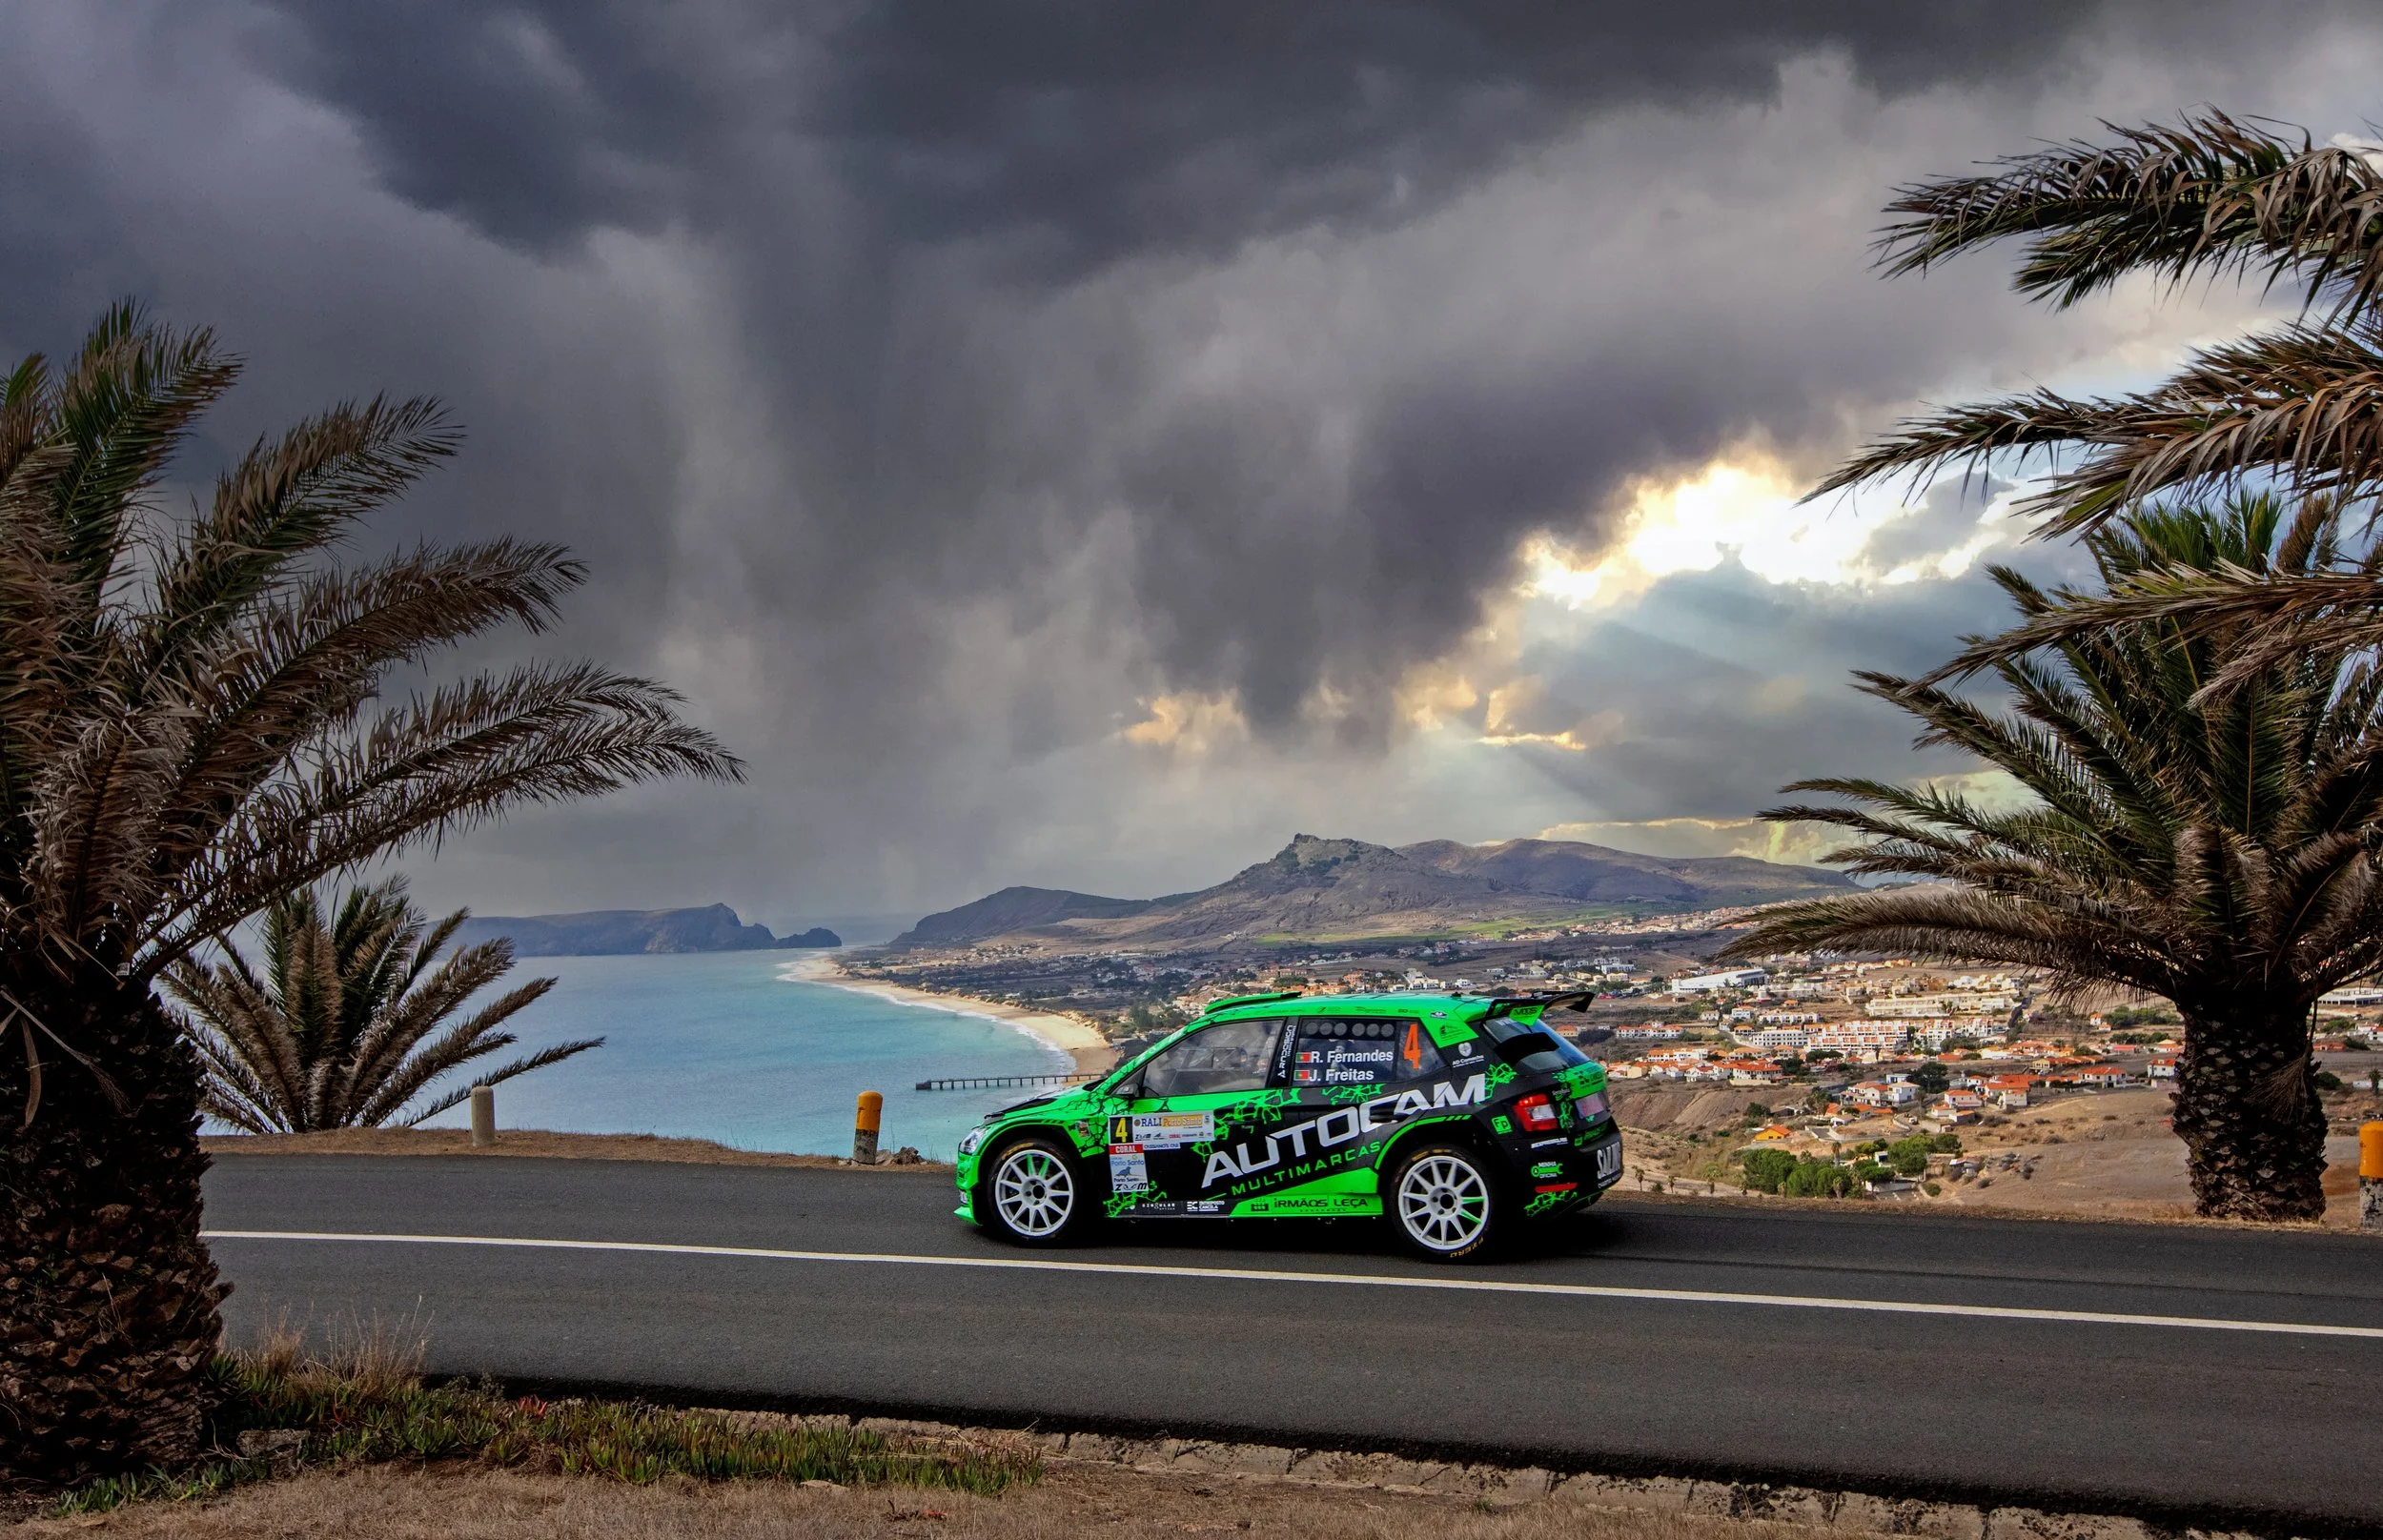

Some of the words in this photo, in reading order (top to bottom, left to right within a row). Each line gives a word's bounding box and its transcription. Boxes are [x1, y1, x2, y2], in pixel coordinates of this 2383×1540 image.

[1310, 1051, 1324, 1064] R.
[1327, 1049, 1394, 1064] Fernandes
[1403, 1023, 1421, 1070] 4
[1309, 1070, 1322, 1082] J.
[1325, 1069, 1375, 1082] Freitas
[1115, 1117, 1129, 1144] 4
[1141, 1117, 1162, 1127] RALI
[1201, 1073, 1486, 1188] AUTOCAM
[1231, 1141, 1381, 1196] MULTIMARCAS
[1334, 1198, 1369, 1208] LEÇA
